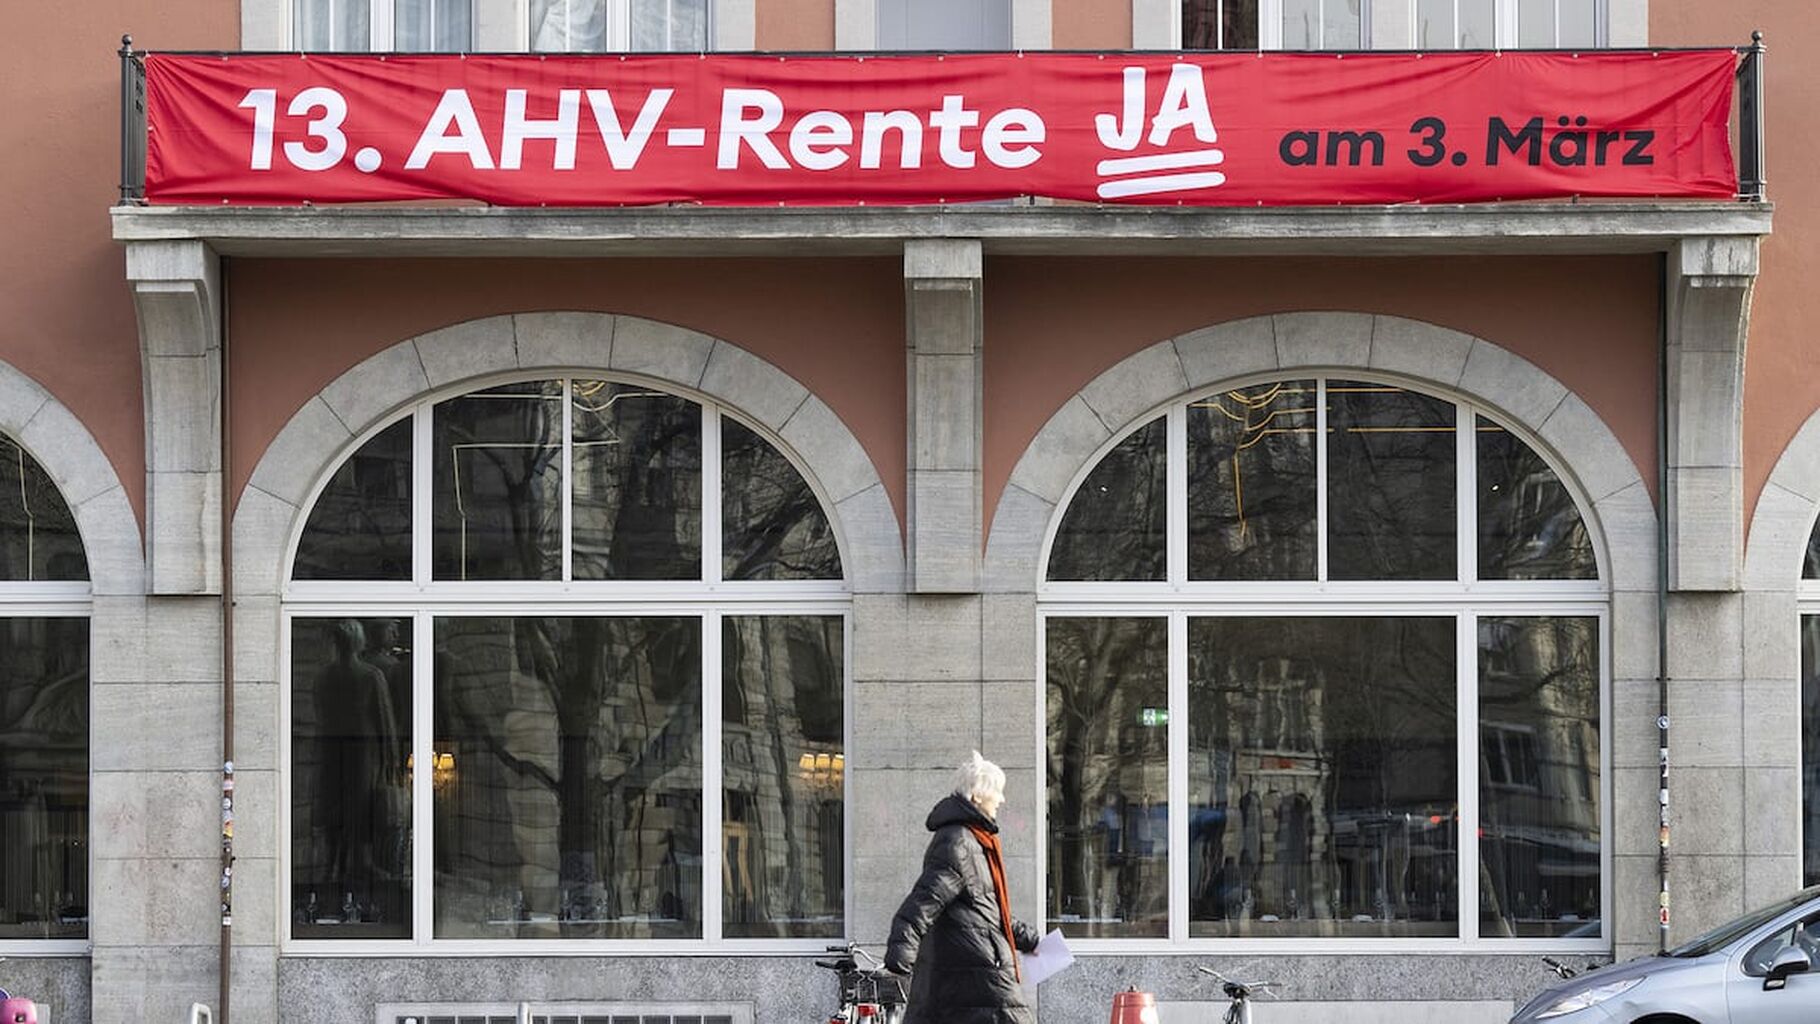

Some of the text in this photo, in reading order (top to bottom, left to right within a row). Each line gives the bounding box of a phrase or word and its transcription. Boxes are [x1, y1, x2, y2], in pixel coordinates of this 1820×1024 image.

[238, 63, 1655, 172] 13. AHV-Rente JA am 3. März
